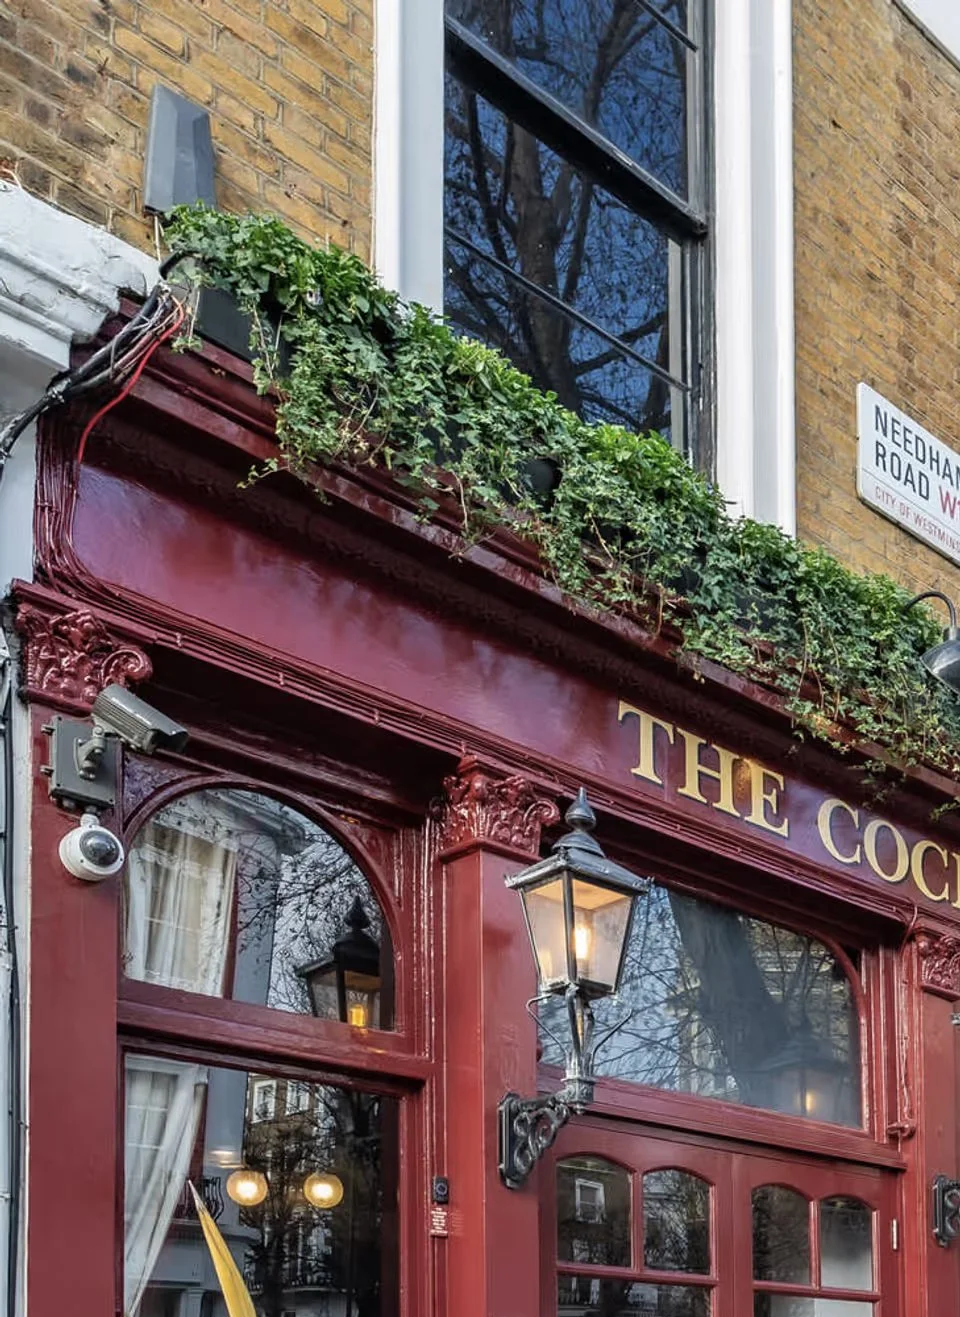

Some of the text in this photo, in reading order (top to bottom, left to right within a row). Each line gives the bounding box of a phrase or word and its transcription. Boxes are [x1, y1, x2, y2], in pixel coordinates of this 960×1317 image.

[874, 440, 930, 501] ROAD
[874, 486, 897, 509] CITY
[899, 502, 910, 519] OF
[617, 700, 789, 838] THE
